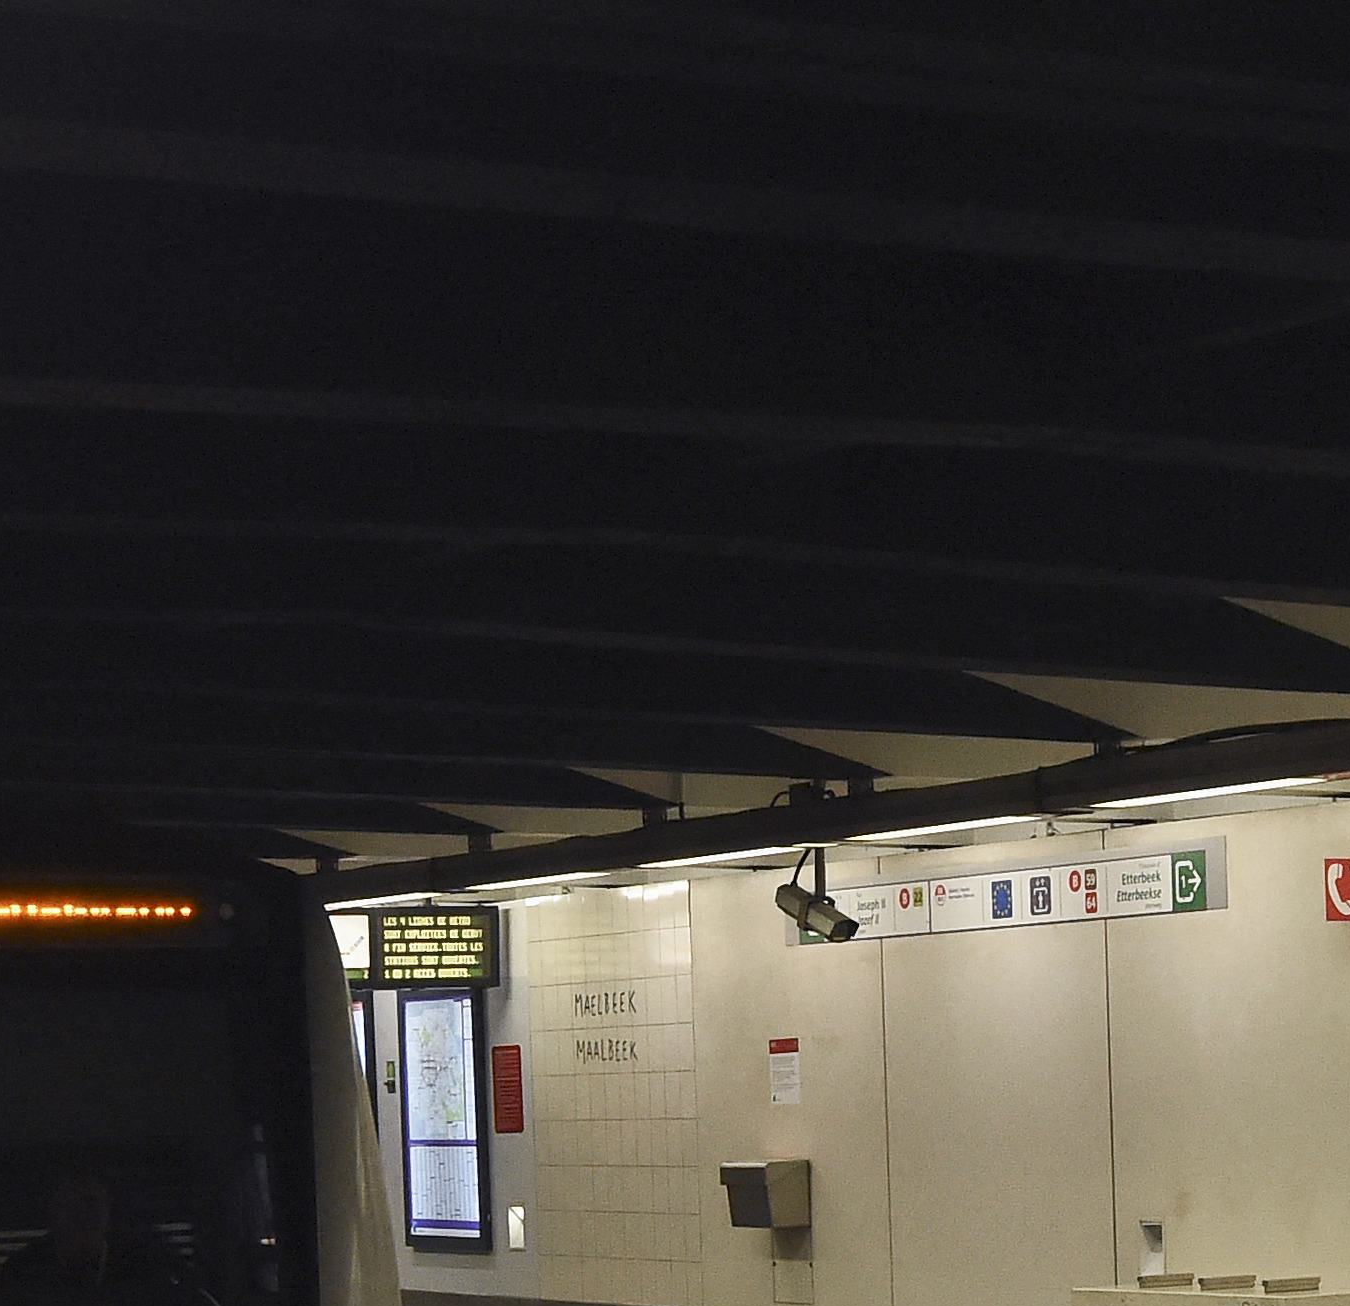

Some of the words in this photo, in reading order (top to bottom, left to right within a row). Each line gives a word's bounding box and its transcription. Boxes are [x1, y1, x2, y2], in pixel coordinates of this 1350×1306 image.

[1072, 876, 1079, 888] B
[1121, 870, 1161, 885] Etterbeek
[901, 892, 908, 904] B
[913, 891, 922, 904] 22
[1086, 896, 1096, 909] 64
[1116, 887, 1162, 903] Etterbeekse
[574, 990, 637, 1018] MAELBEEK
[576, 1038, 639, 1064] MAALBEEK
